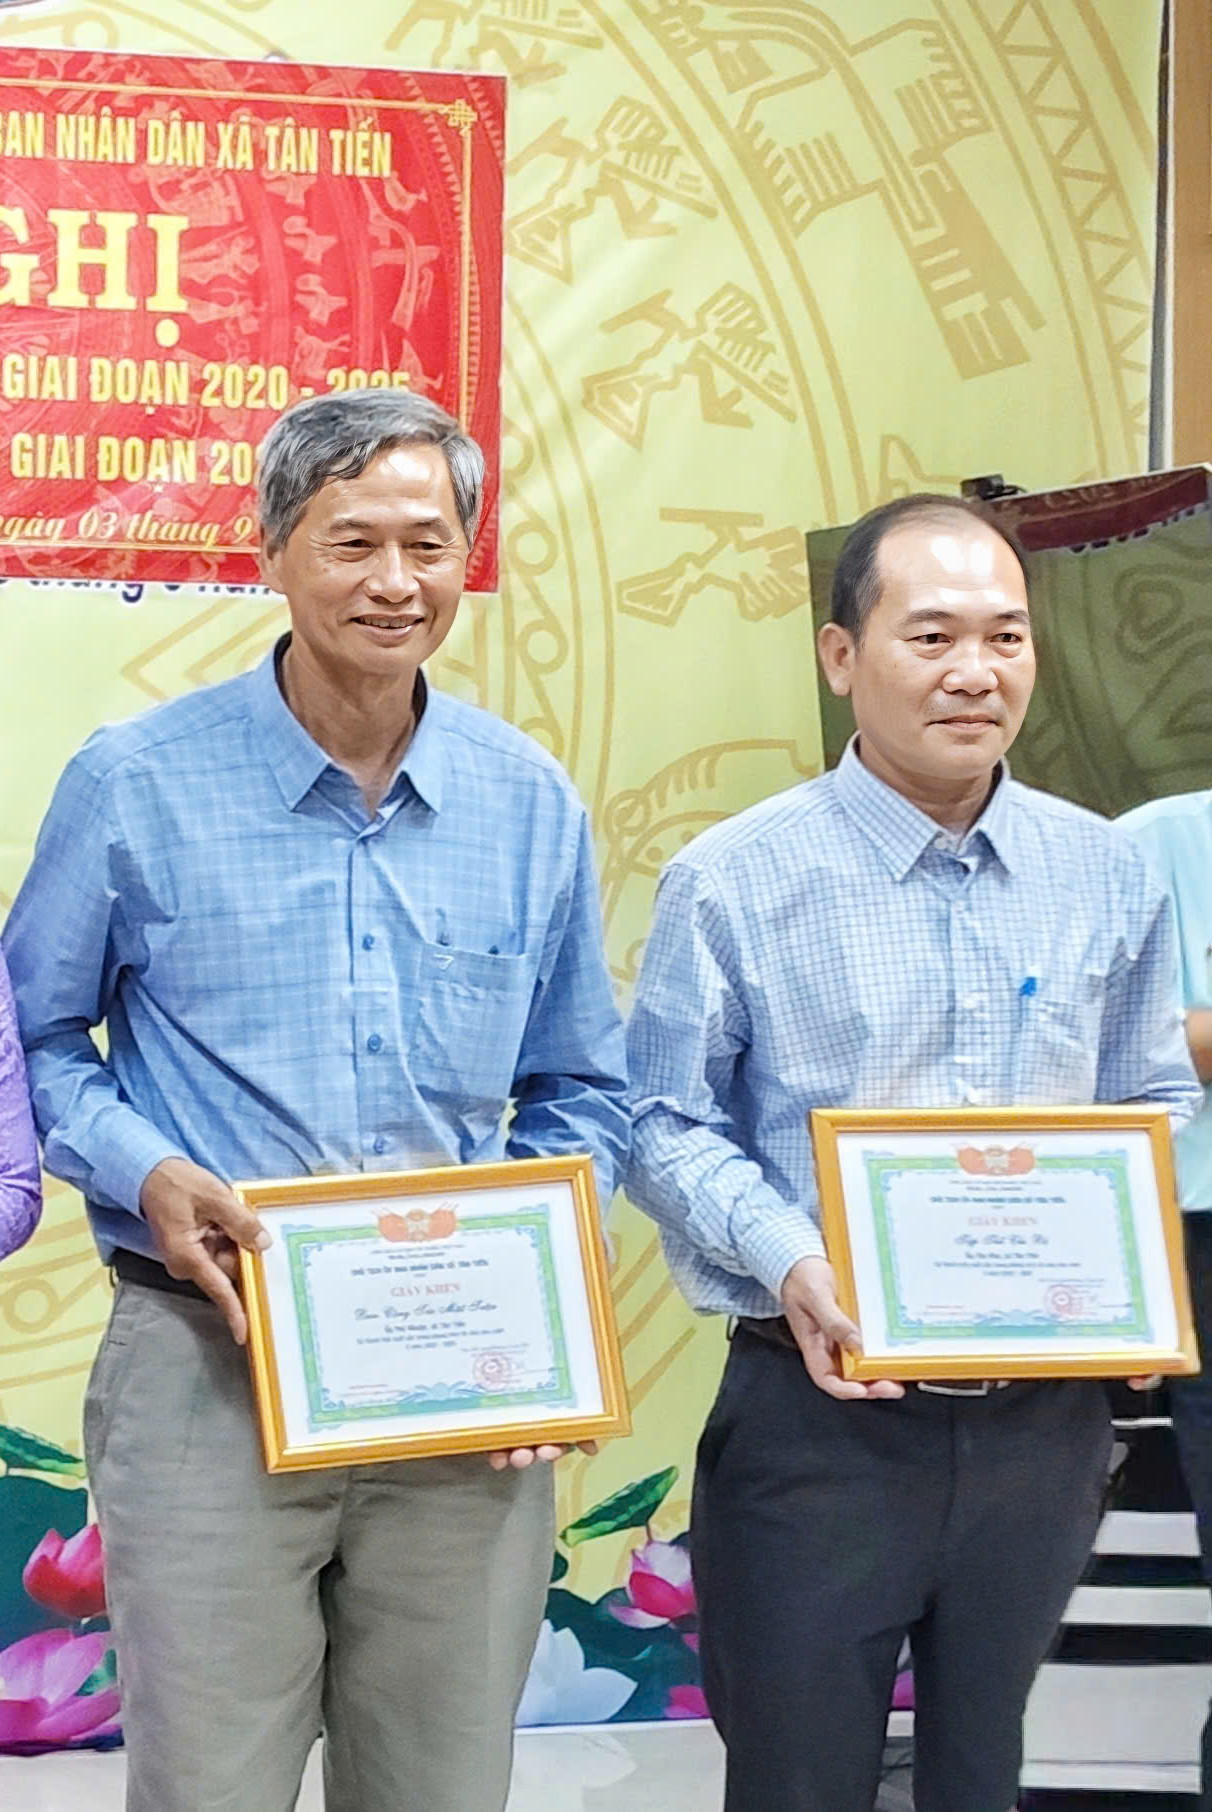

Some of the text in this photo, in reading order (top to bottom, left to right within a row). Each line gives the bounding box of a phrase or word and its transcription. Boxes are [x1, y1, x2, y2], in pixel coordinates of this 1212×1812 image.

[56, 106, 137, 165] NHÂN
[147, 110, 206, 168] DÂN
[216, 115, 254, 171] XÃ
[266, 118, 319, 175] TÂN
[331, 115, 392, 178] TIẾN
[2, 353, 78, 402] GIAI
[90, 357, 189, 415] ĐOẠN
[200, 362, 289, 411] 2020
[10, 433, 86, 481] GIAI
[96, 436, 197, 494] ĐOẠN
[209, 440, 260, 487] 20
[77, 510, 119, 540] 03
[125, 509, 220, 550] tháng
[231, 515, 255, 545] 9
